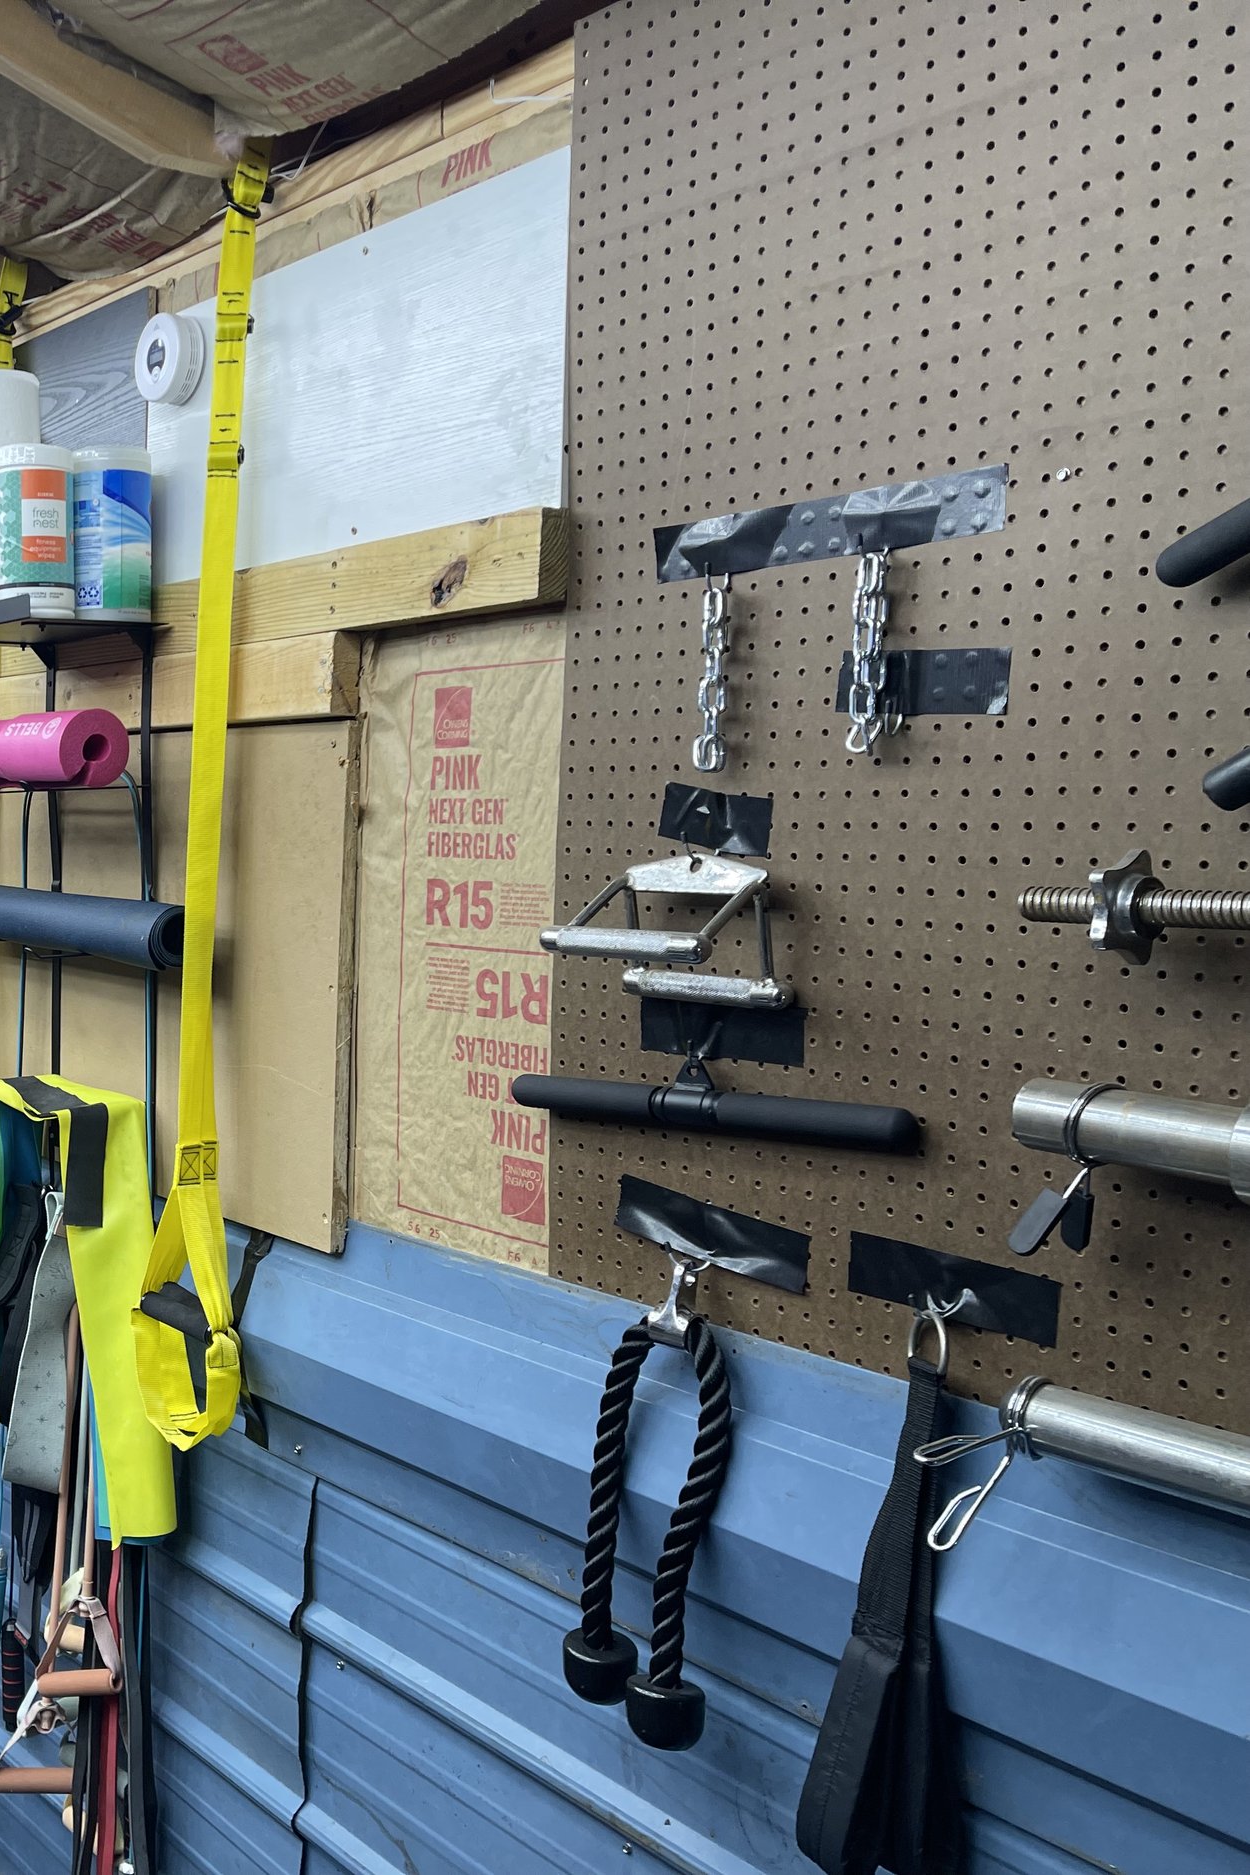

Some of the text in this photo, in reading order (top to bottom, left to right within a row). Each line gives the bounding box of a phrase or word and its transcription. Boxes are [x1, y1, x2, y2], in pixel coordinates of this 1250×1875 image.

[441, 133, 495, 188] PINK
[32, 507, 59, 519] fresh
[33, 519, 59, 529] nest
[29, 546, 62, 554] equipment
[36, 538, 56, 546] fitness
[37, 552, 55, 560] wipes
[4, 722, 44, 737] BELLS
[443, 719, 468, 729] OWENS
[437, 730, 468, 740] CORNING
[430, 754, 482, 790] PINK
[428, 798, 504, 825] NEXT GEN
[427, 832, 516, 860] FIBERGLAS
[426, 878, 493, 930] R15
[476, 969, 548, 1025] R15
[455, 1034, 548, 1074] FIBERGLAS
[467, 1070, 499, 1100] GEN
[491, 1109, 547, 1155] PINK
[505, 1163, 541, 1182] CORNING
[505, 1174, 535, 1192] OWENS
[429, 1227, 441, 1240] 25
